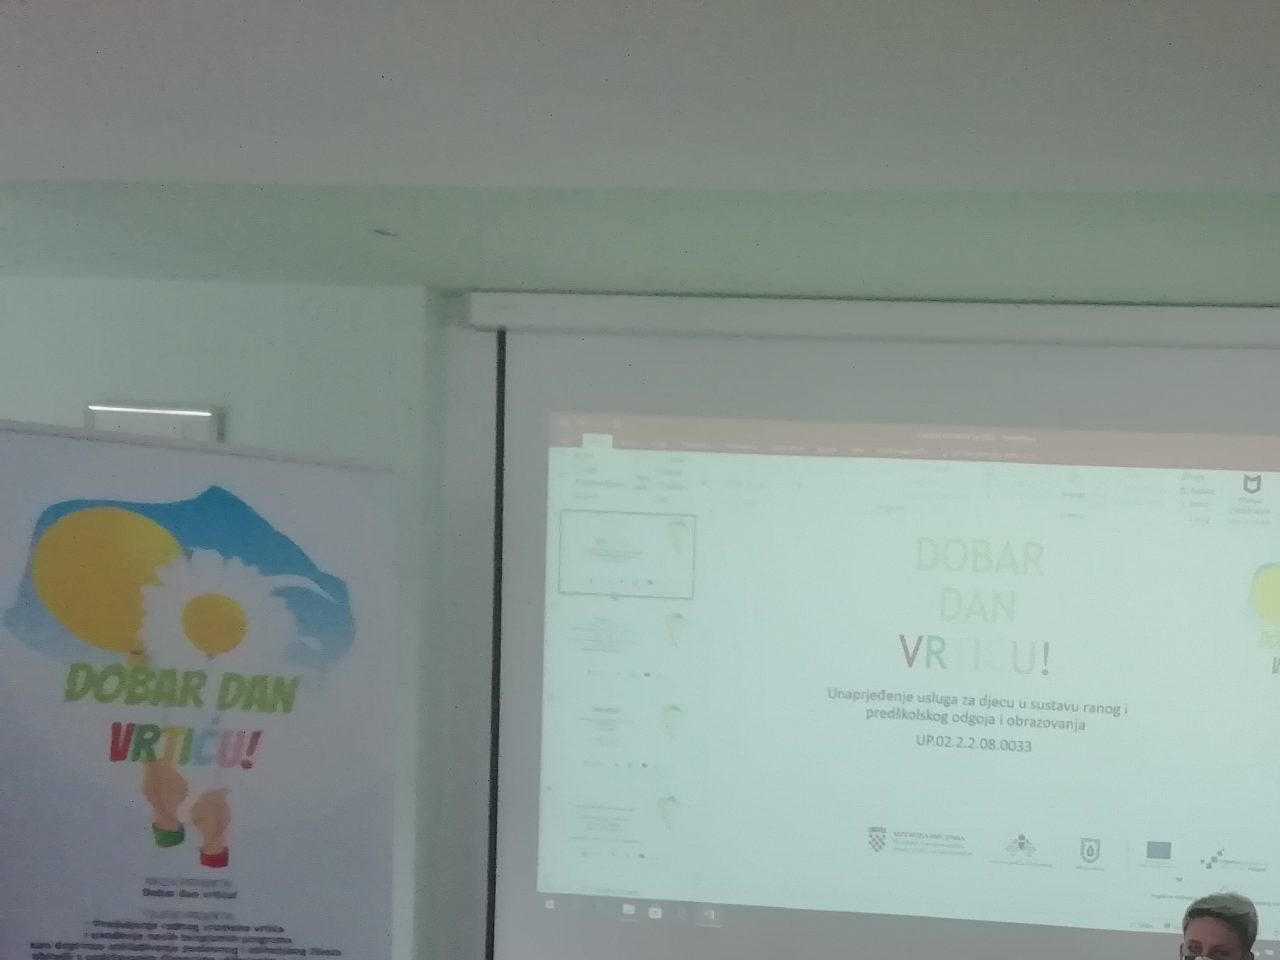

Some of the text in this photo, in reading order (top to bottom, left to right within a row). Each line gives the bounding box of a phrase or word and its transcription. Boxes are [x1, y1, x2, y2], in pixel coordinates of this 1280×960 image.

[915, 536, 1045, 576] DOBAR
[939, 587, 1016, 624] DAN
[898, 633, 1050, 676] VRIU!
[64, 662, 301, 713] DOBAR DAN
[827, 687, 1129, 717] Unaprjeđenje usluga za djecu u sustavu ranog i
[865, 706, 1086, 732] predškolskog odgoja i obrazovanja
[109, 716, 264, 769] VRTIĆU!
[916, 734, 1033, 753] UP.02.2.2.08.0033
